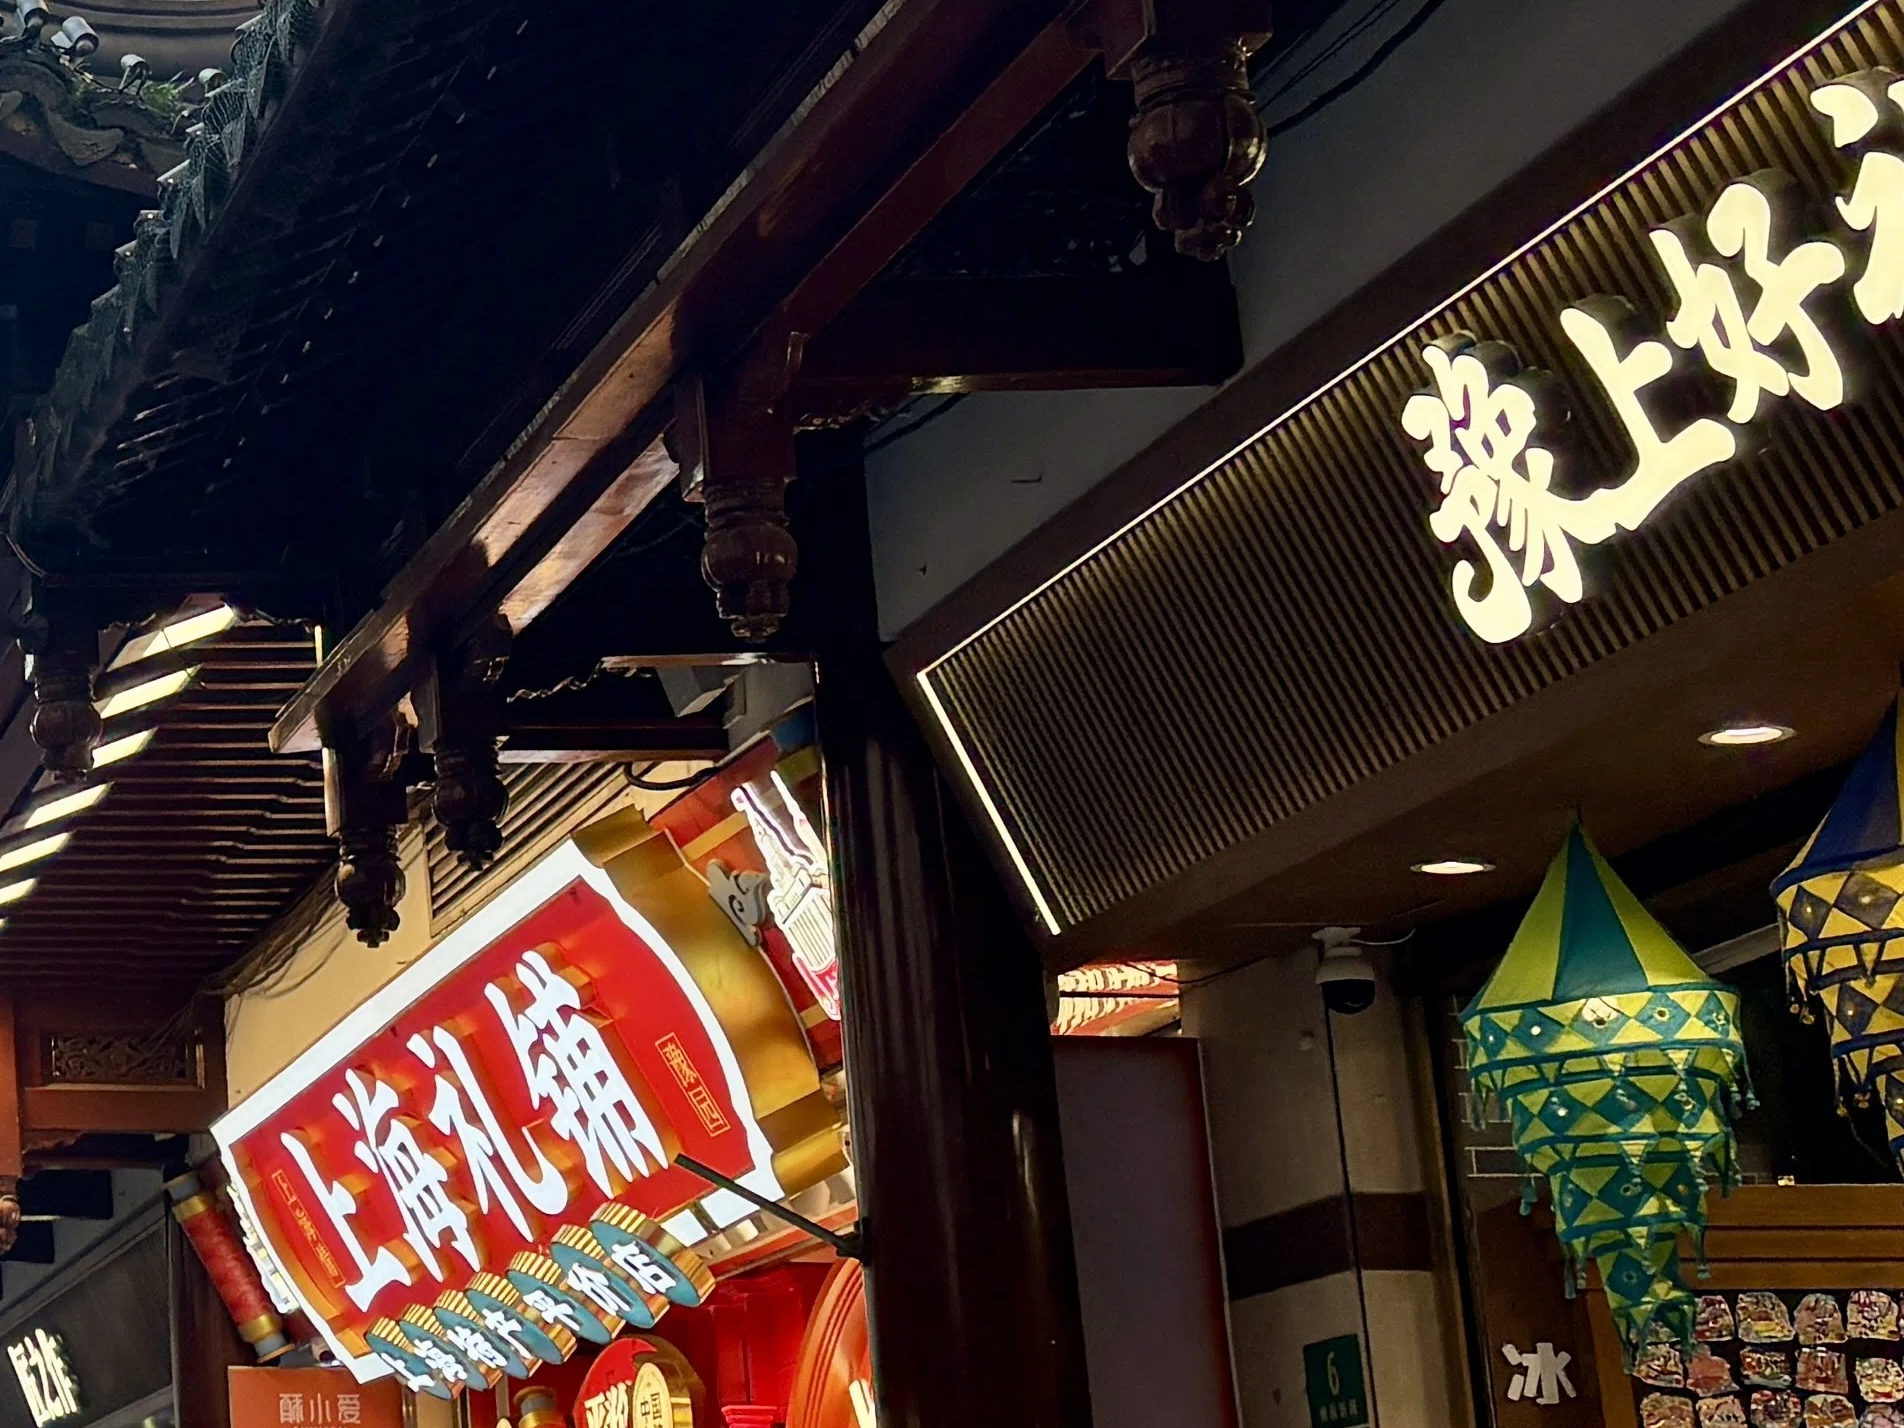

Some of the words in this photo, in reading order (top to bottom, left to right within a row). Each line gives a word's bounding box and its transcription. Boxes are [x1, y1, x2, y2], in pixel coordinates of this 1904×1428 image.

[281, 950, 670, 1313] 上海礼铺
[279, 1392, 361, 1424] 酥小爱
